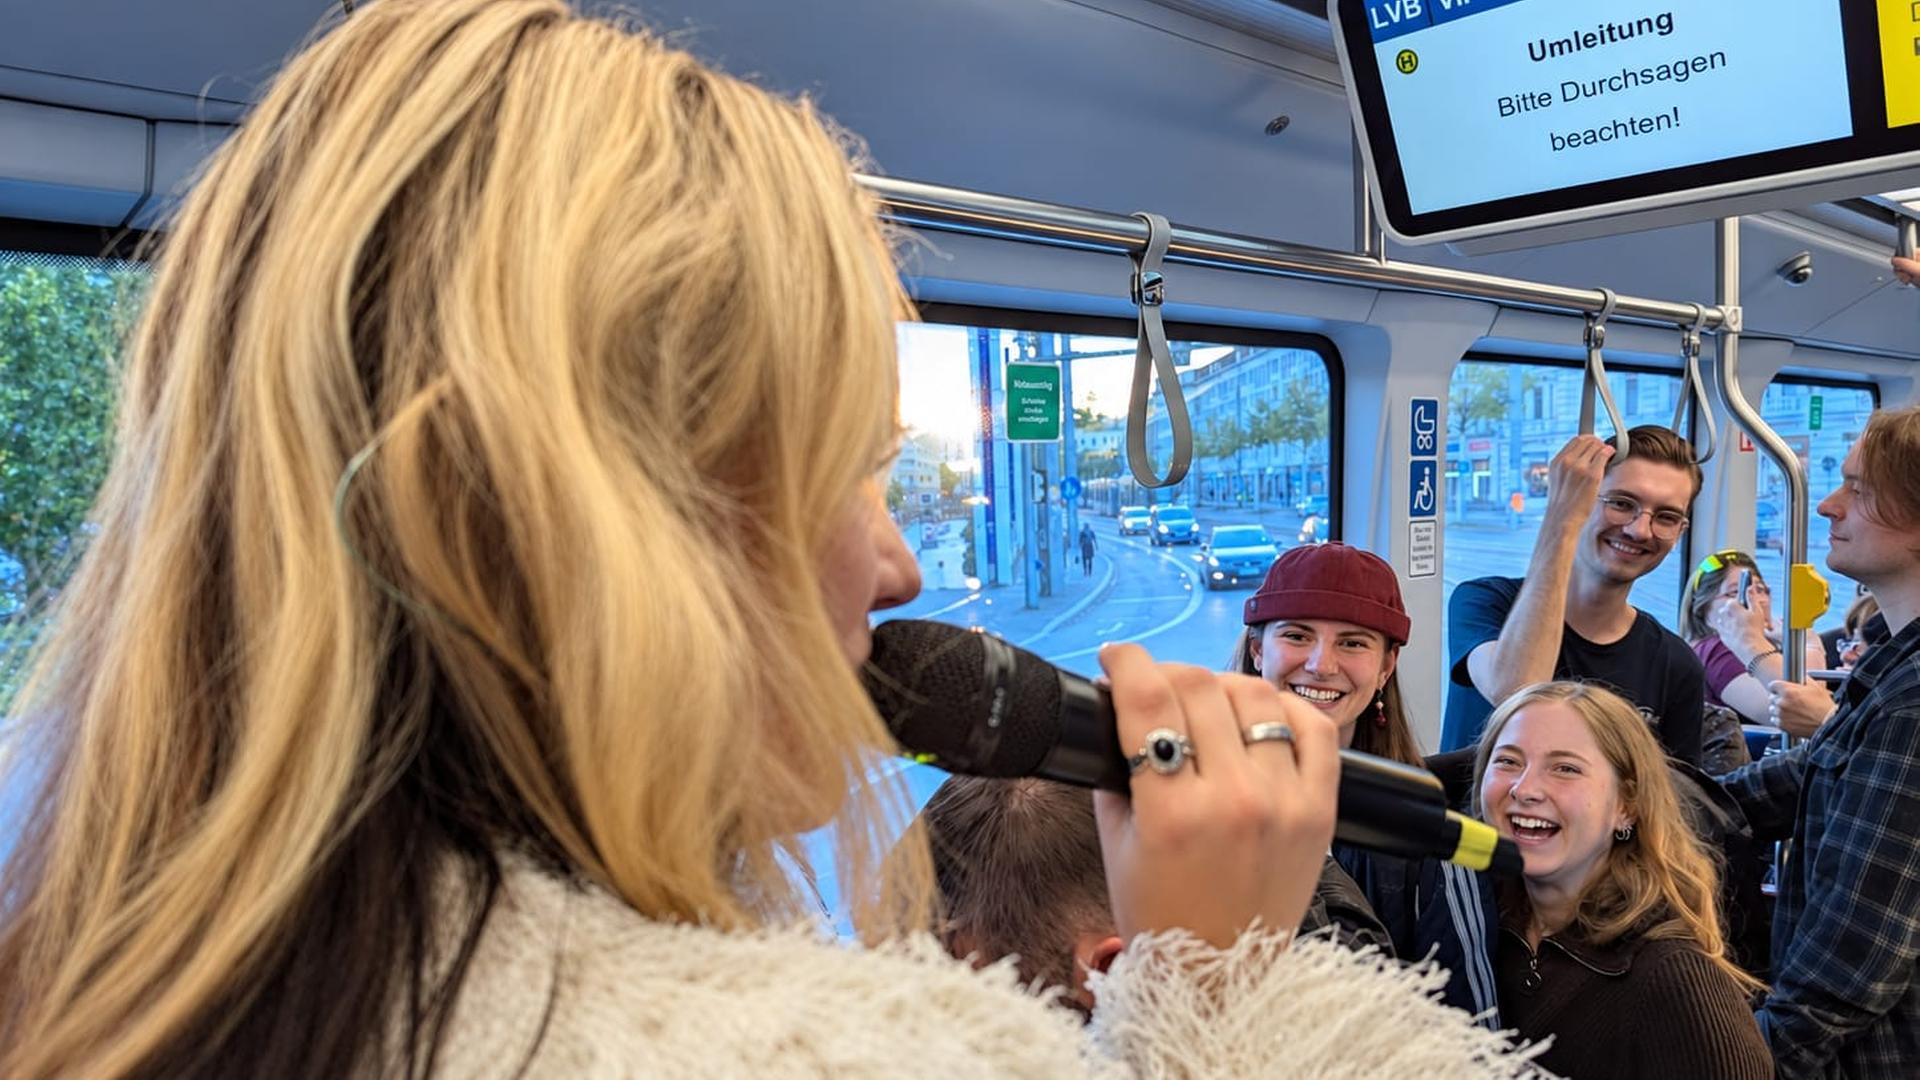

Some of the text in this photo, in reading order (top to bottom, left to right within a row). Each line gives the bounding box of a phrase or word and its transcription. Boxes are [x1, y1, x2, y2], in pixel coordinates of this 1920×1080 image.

[1371, 0, 1422, 29] LVB
[1527, 12, 1674, 62] Umleitung
[1497, 51, 1727, 118] Bitte Durchsagen
[1549, 106, 1682, 152] beachten!
